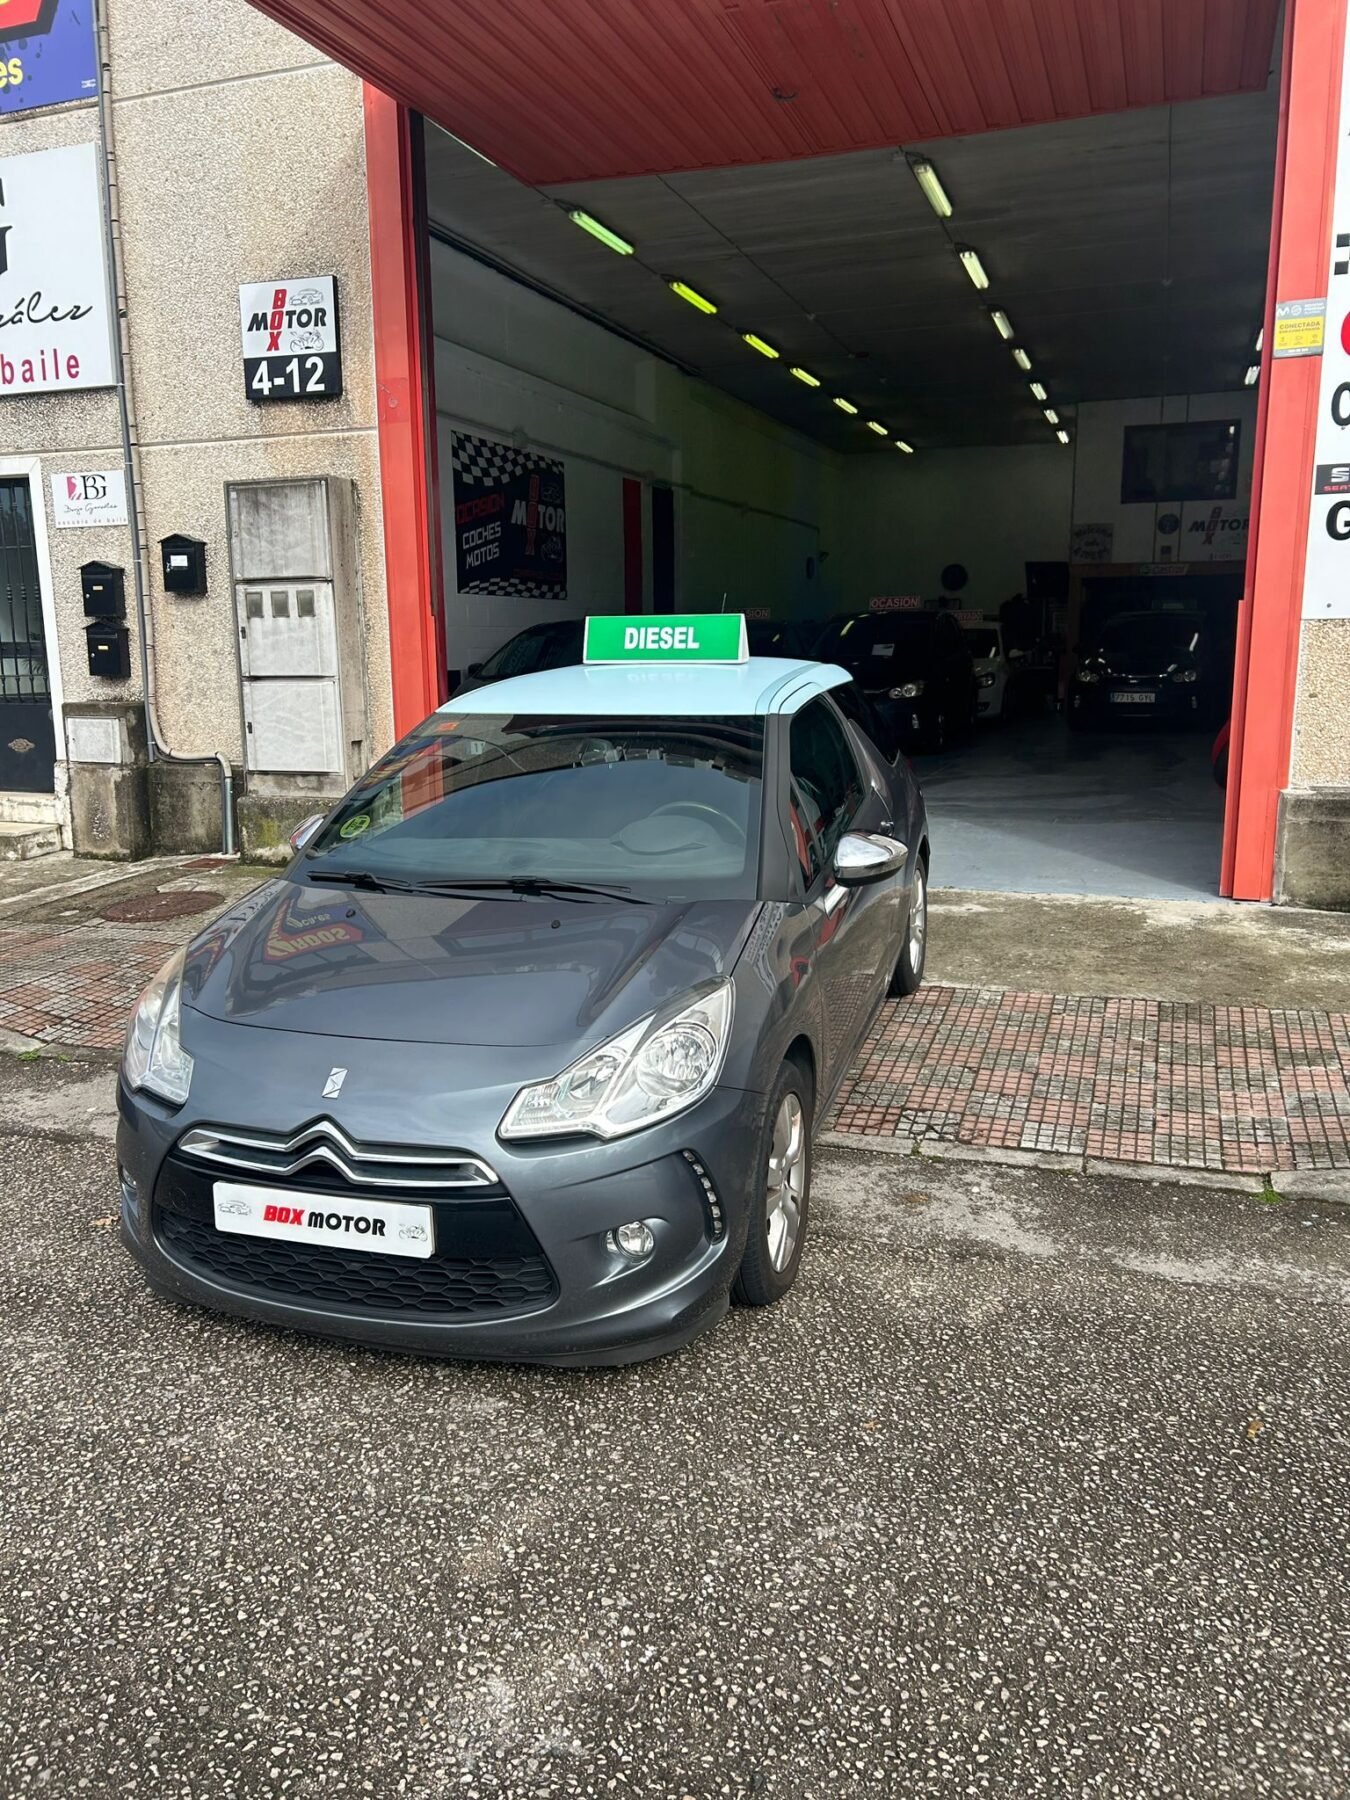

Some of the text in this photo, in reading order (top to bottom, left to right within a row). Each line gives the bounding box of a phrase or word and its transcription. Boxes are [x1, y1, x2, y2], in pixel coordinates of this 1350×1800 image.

[0, 291, 93, 327] ález
[247, 307, 327, 332] MOTOR
[267, 289, 287, 352] BOX
[0, 348, 80, 385] baile
[252, 356, 325, 395] 4-12
[462, 521, 502, 550] COCHES
[465, 542, 500, 570] MOTOS
[870, 597, 918, 609] OCASION
[624, 626, 700, 650] DIESEL
[263, 1204, 386, 1237] BOX MOTOR
